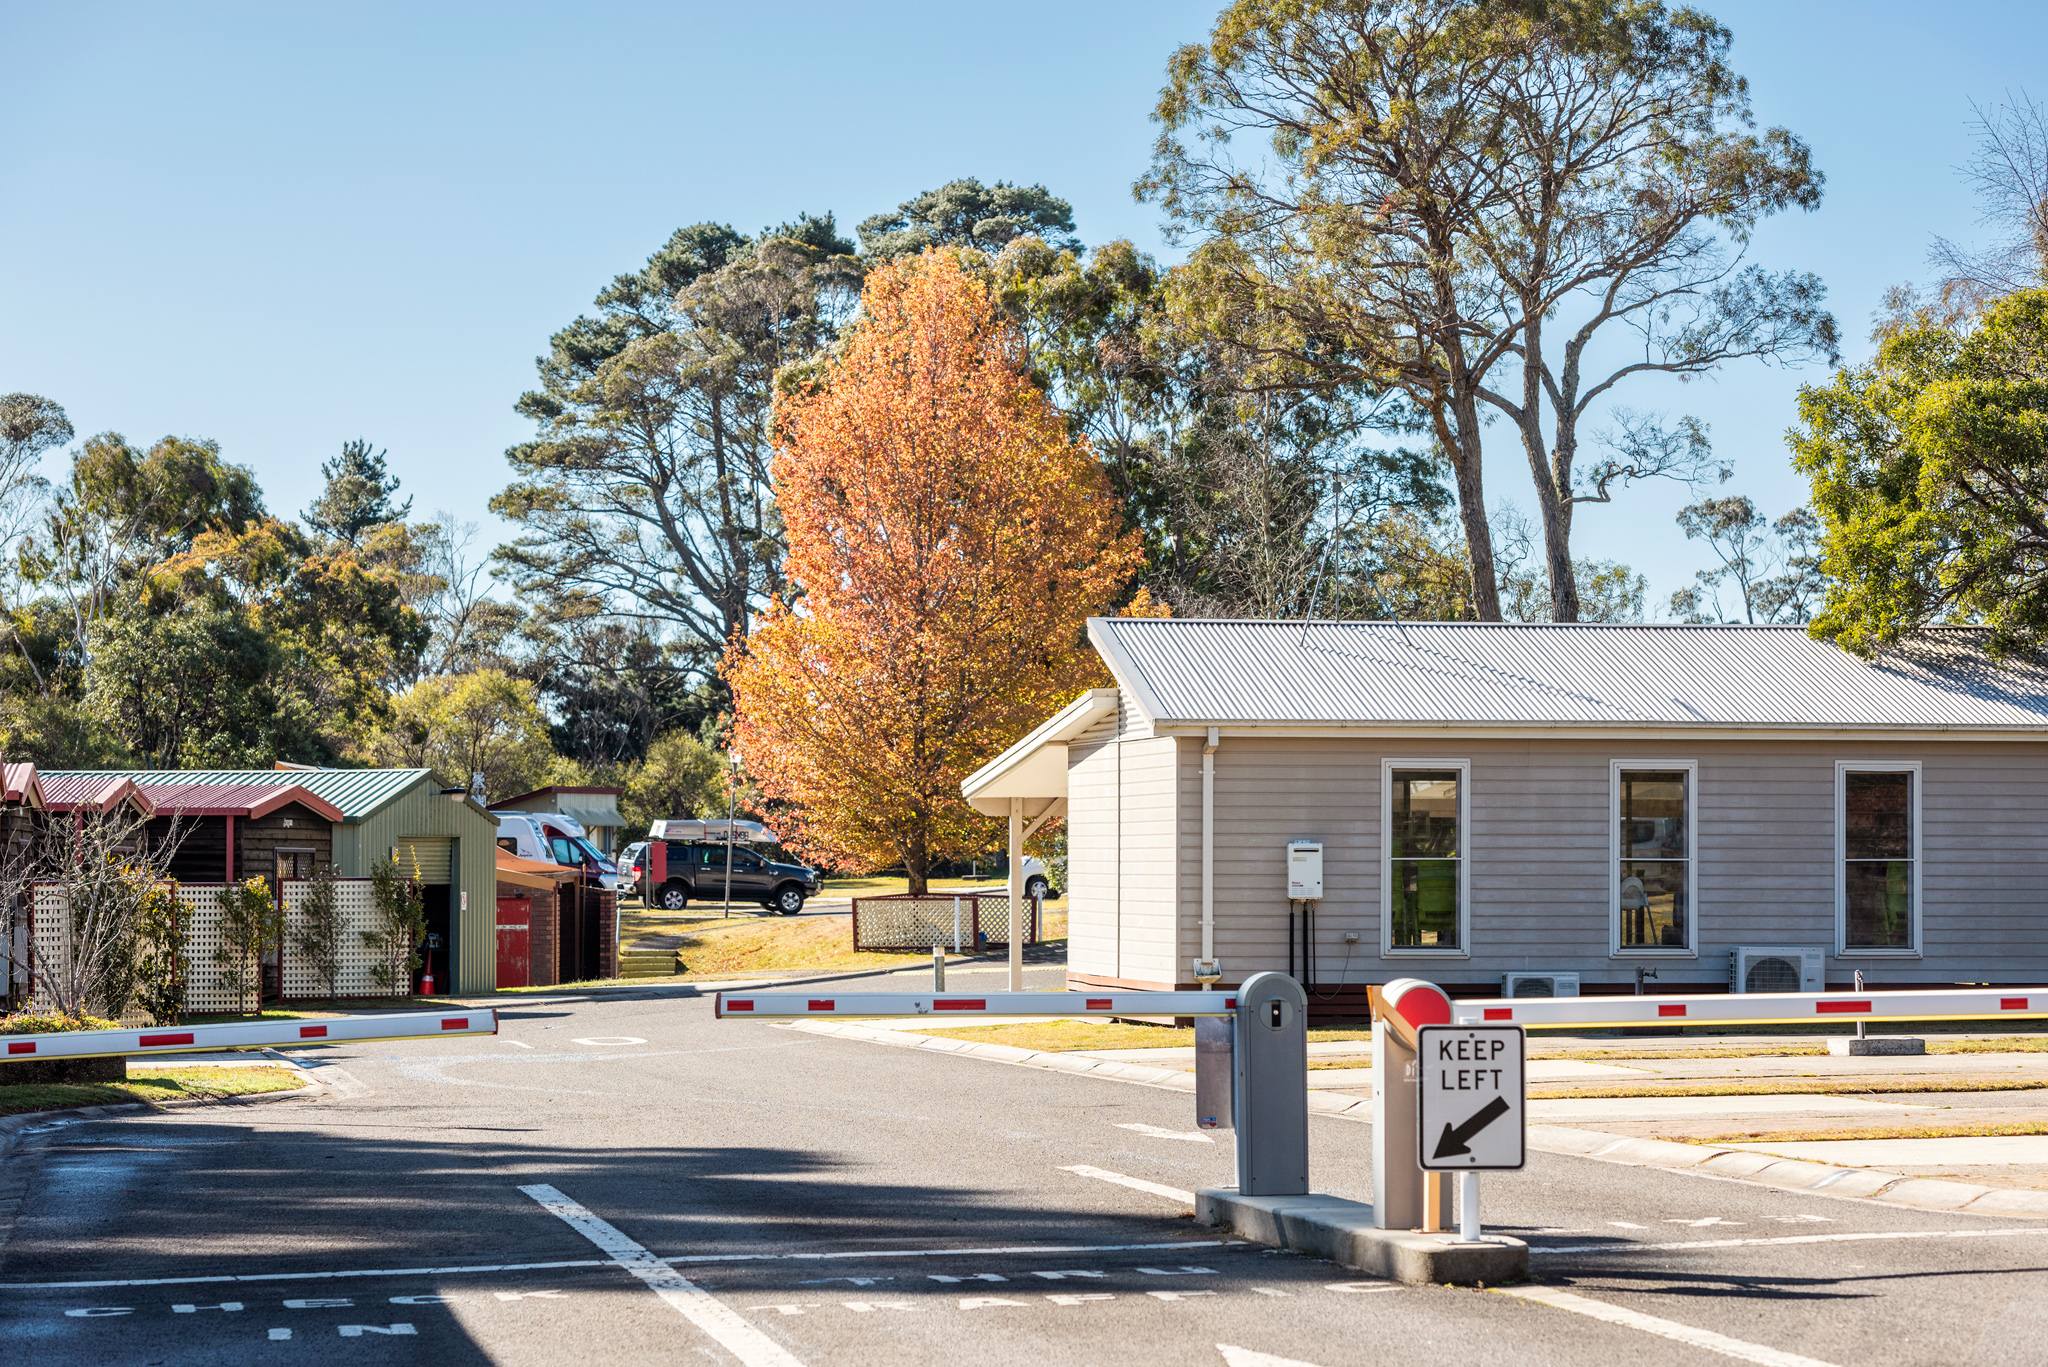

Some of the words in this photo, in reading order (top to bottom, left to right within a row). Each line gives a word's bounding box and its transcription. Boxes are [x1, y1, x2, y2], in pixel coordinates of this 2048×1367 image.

[1440, 1040, 1505, 1060] KEEP
[1442, 1070, 1503, 1090] LEFT
[799, 1266, 1220, 1286] THRU
[64, 1289, 569, 1317] CHECK
[746, 1281, 1405, 1315] TRAFFIC
[267, 1323, 419, 1341] IN
